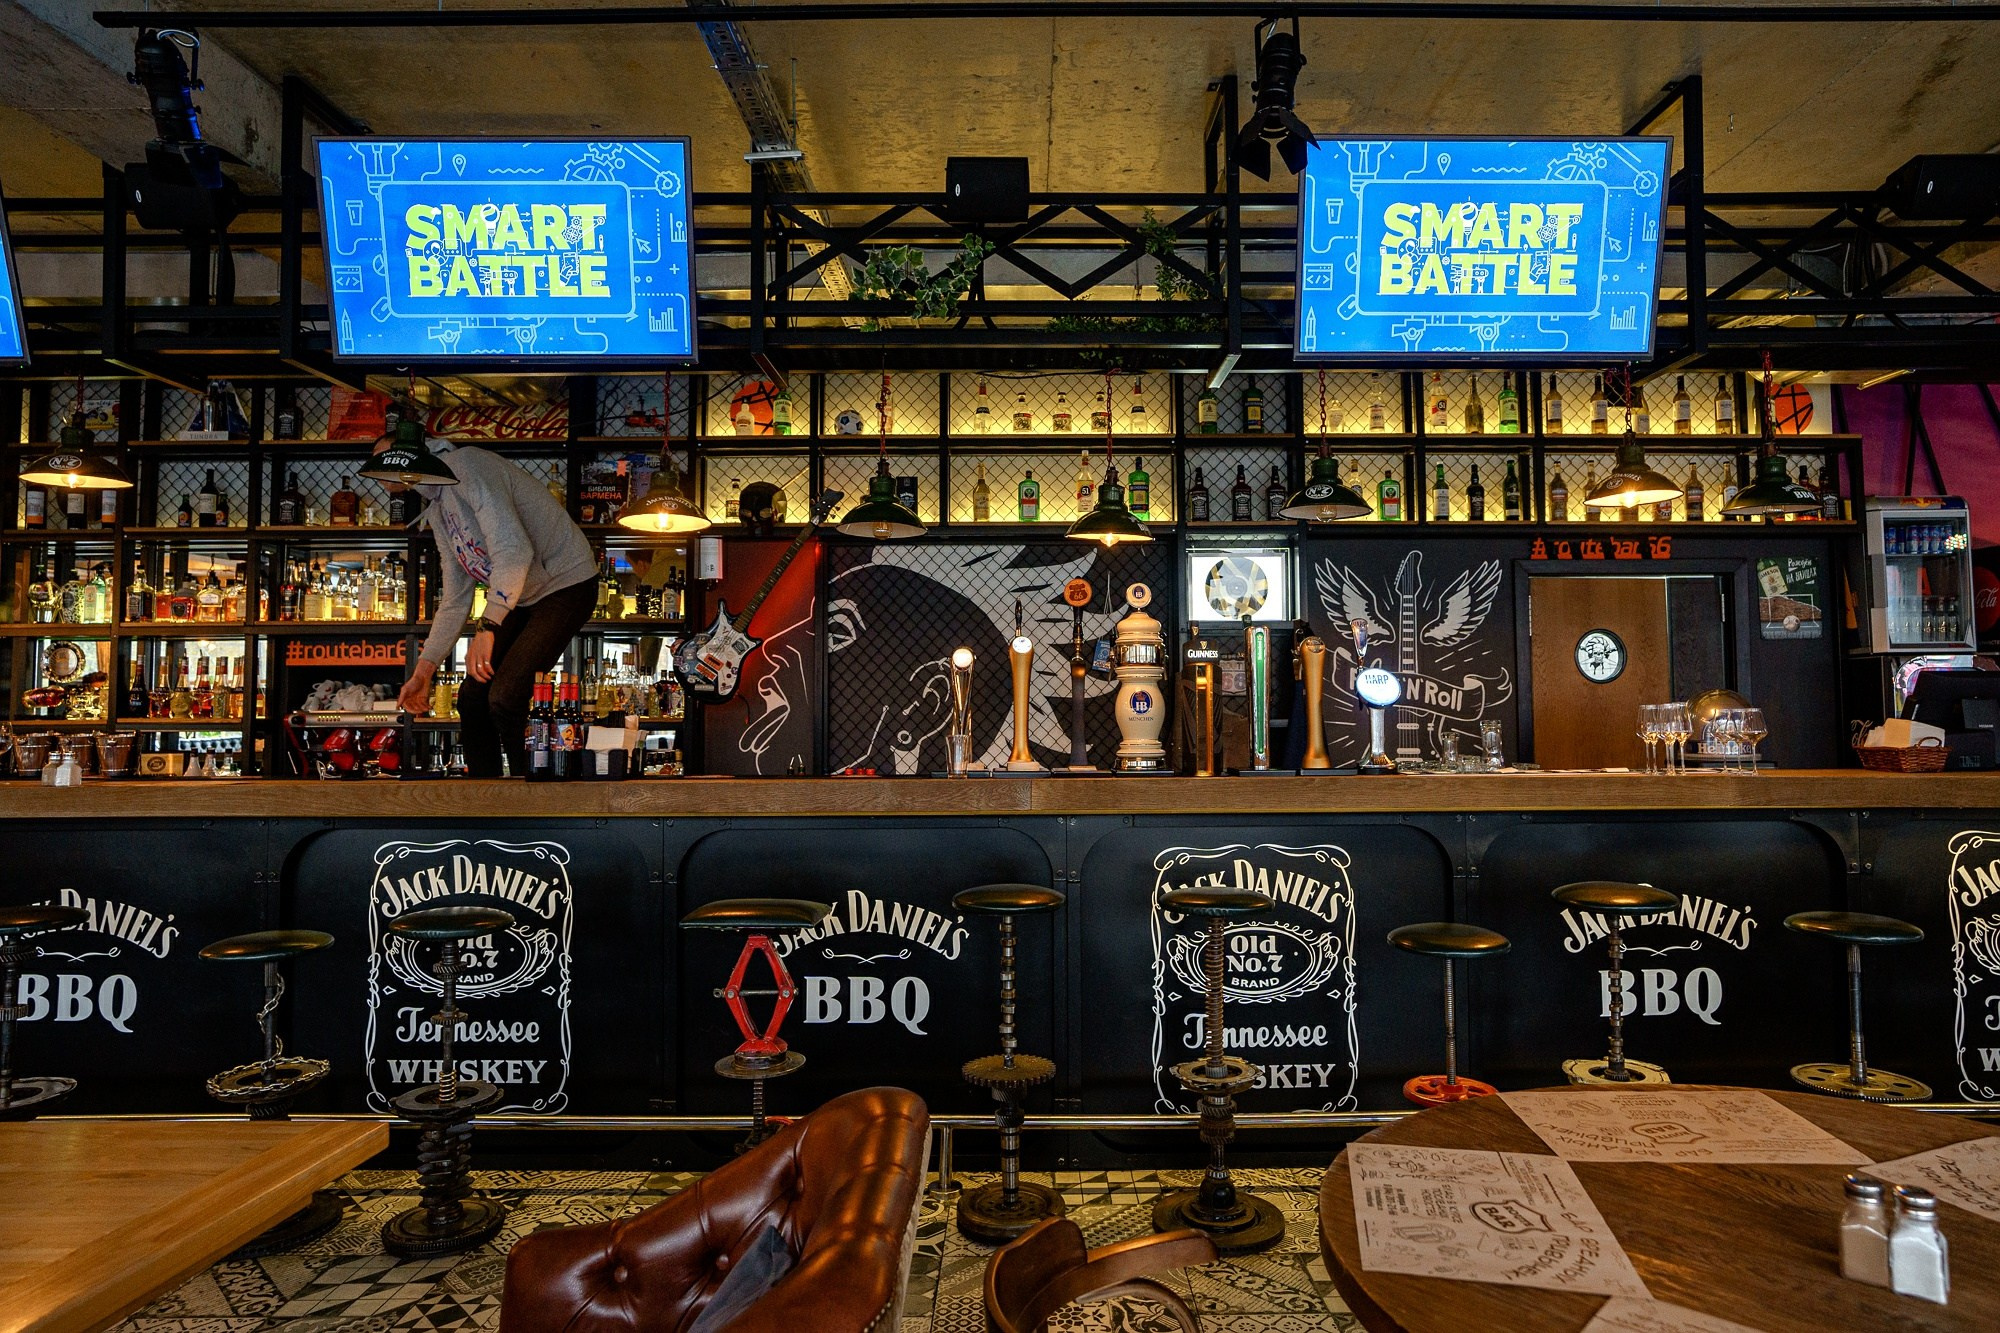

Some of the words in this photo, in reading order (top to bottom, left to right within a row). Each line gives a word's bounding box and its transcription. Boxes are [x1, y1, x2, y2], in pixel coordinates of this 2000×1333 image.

[405, 203, 606, 250] SMART
[1380, 202, 1584, 249] SMART
[408, 254, 611, 298] BATTLE
[1376, 253, 1578, 296] BATTLE
[382, 457, 410, 467] BBQ
[580, 491, 622, 500] БАРМЕНА
[1081, 487, 1090, 495] 51
[1073, 591, 1084, 600] 66
[1187, 649, 1219, 658] GUINNESS
[1364, 674, 1389, 685] HARP
[1135, 701, 1148, 711] HB
[379, 865, 451, 918] JACK
[452, 854, 565, 920] DANIEL'S
[1232, 858, 1346, 924] DANIEL'S
[846, 889, 971, 961] DANIEL'S
[1230, 935, 1278, 955] Old
[464, 949, 499, 969] o.7
[1225, 953, 1284, 974] No.7
[1230, 976, 1281, 989] BRAND
[16, 973, 139, 1034] BBQ
[803, 975, 933, 1036] BBQ
[1597, 966, 1724, 1027] BBQ
[1182, 1012, 1329, 1050] Tnnessee
[386, 1058, 548, 1085] WHISKEY
[1639, 1124, 1680, 1135] BAR
[1482, 1206, 1516, 1229] BAR
[1503, 1205, 1535, 1227] ROUTE
[1560, 1211, 1594, 1233] БАР
